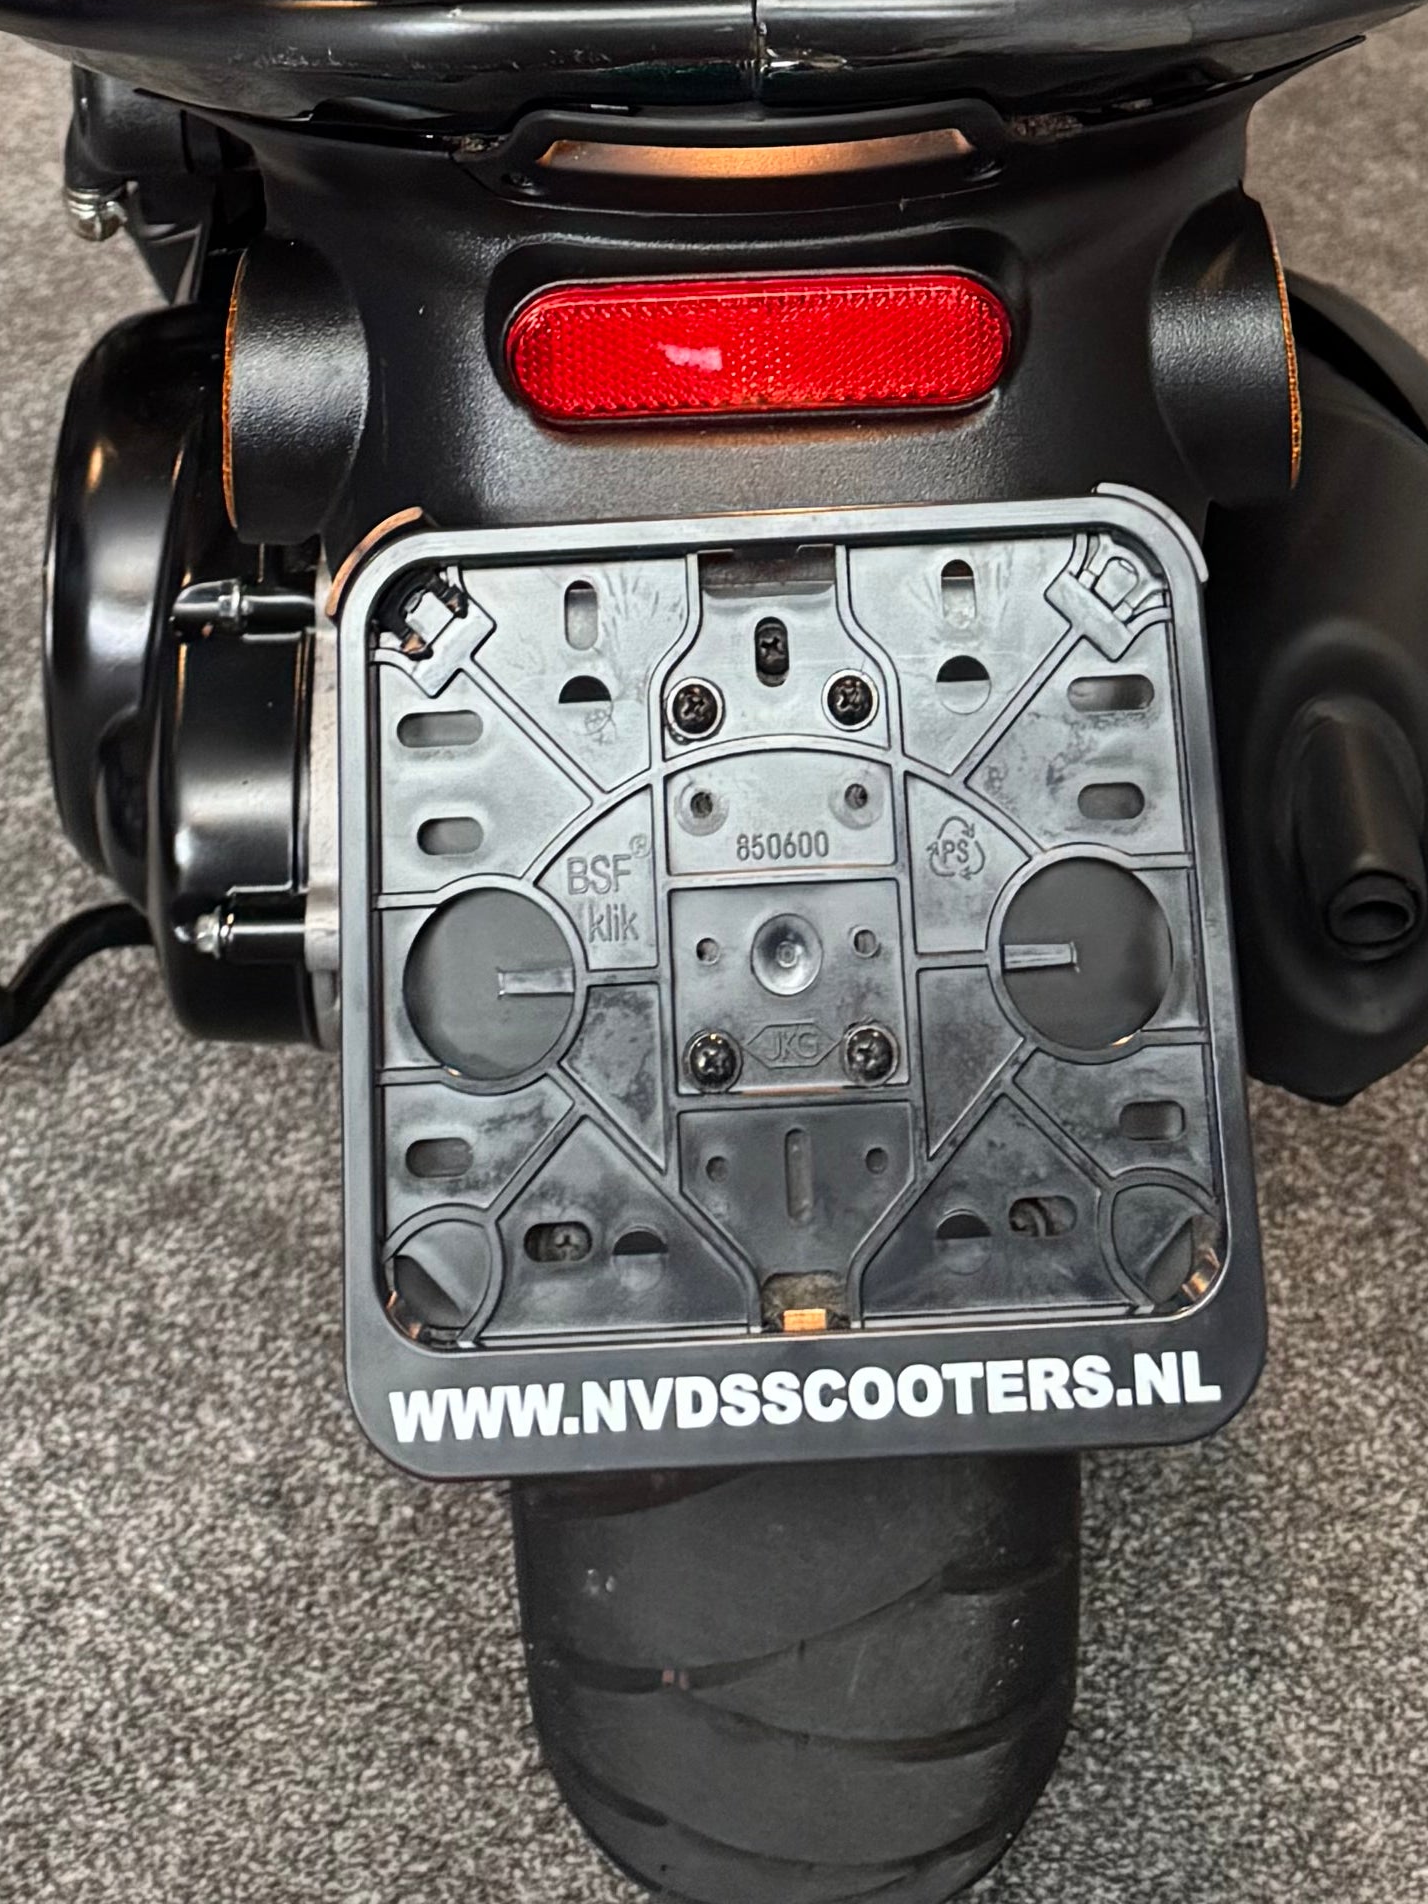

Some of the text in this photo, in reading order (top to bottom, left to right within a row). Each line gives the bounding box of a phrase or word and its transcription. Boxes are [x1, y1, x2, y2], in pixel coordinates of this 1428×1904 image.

[736, 829, 830, 862] 850600
[941, 838, 970, 865] PS
[588, 902, 640, 943] klik
[388, 1350, 1222, 1444] WWW.NVDSSCOOTERS.NL
